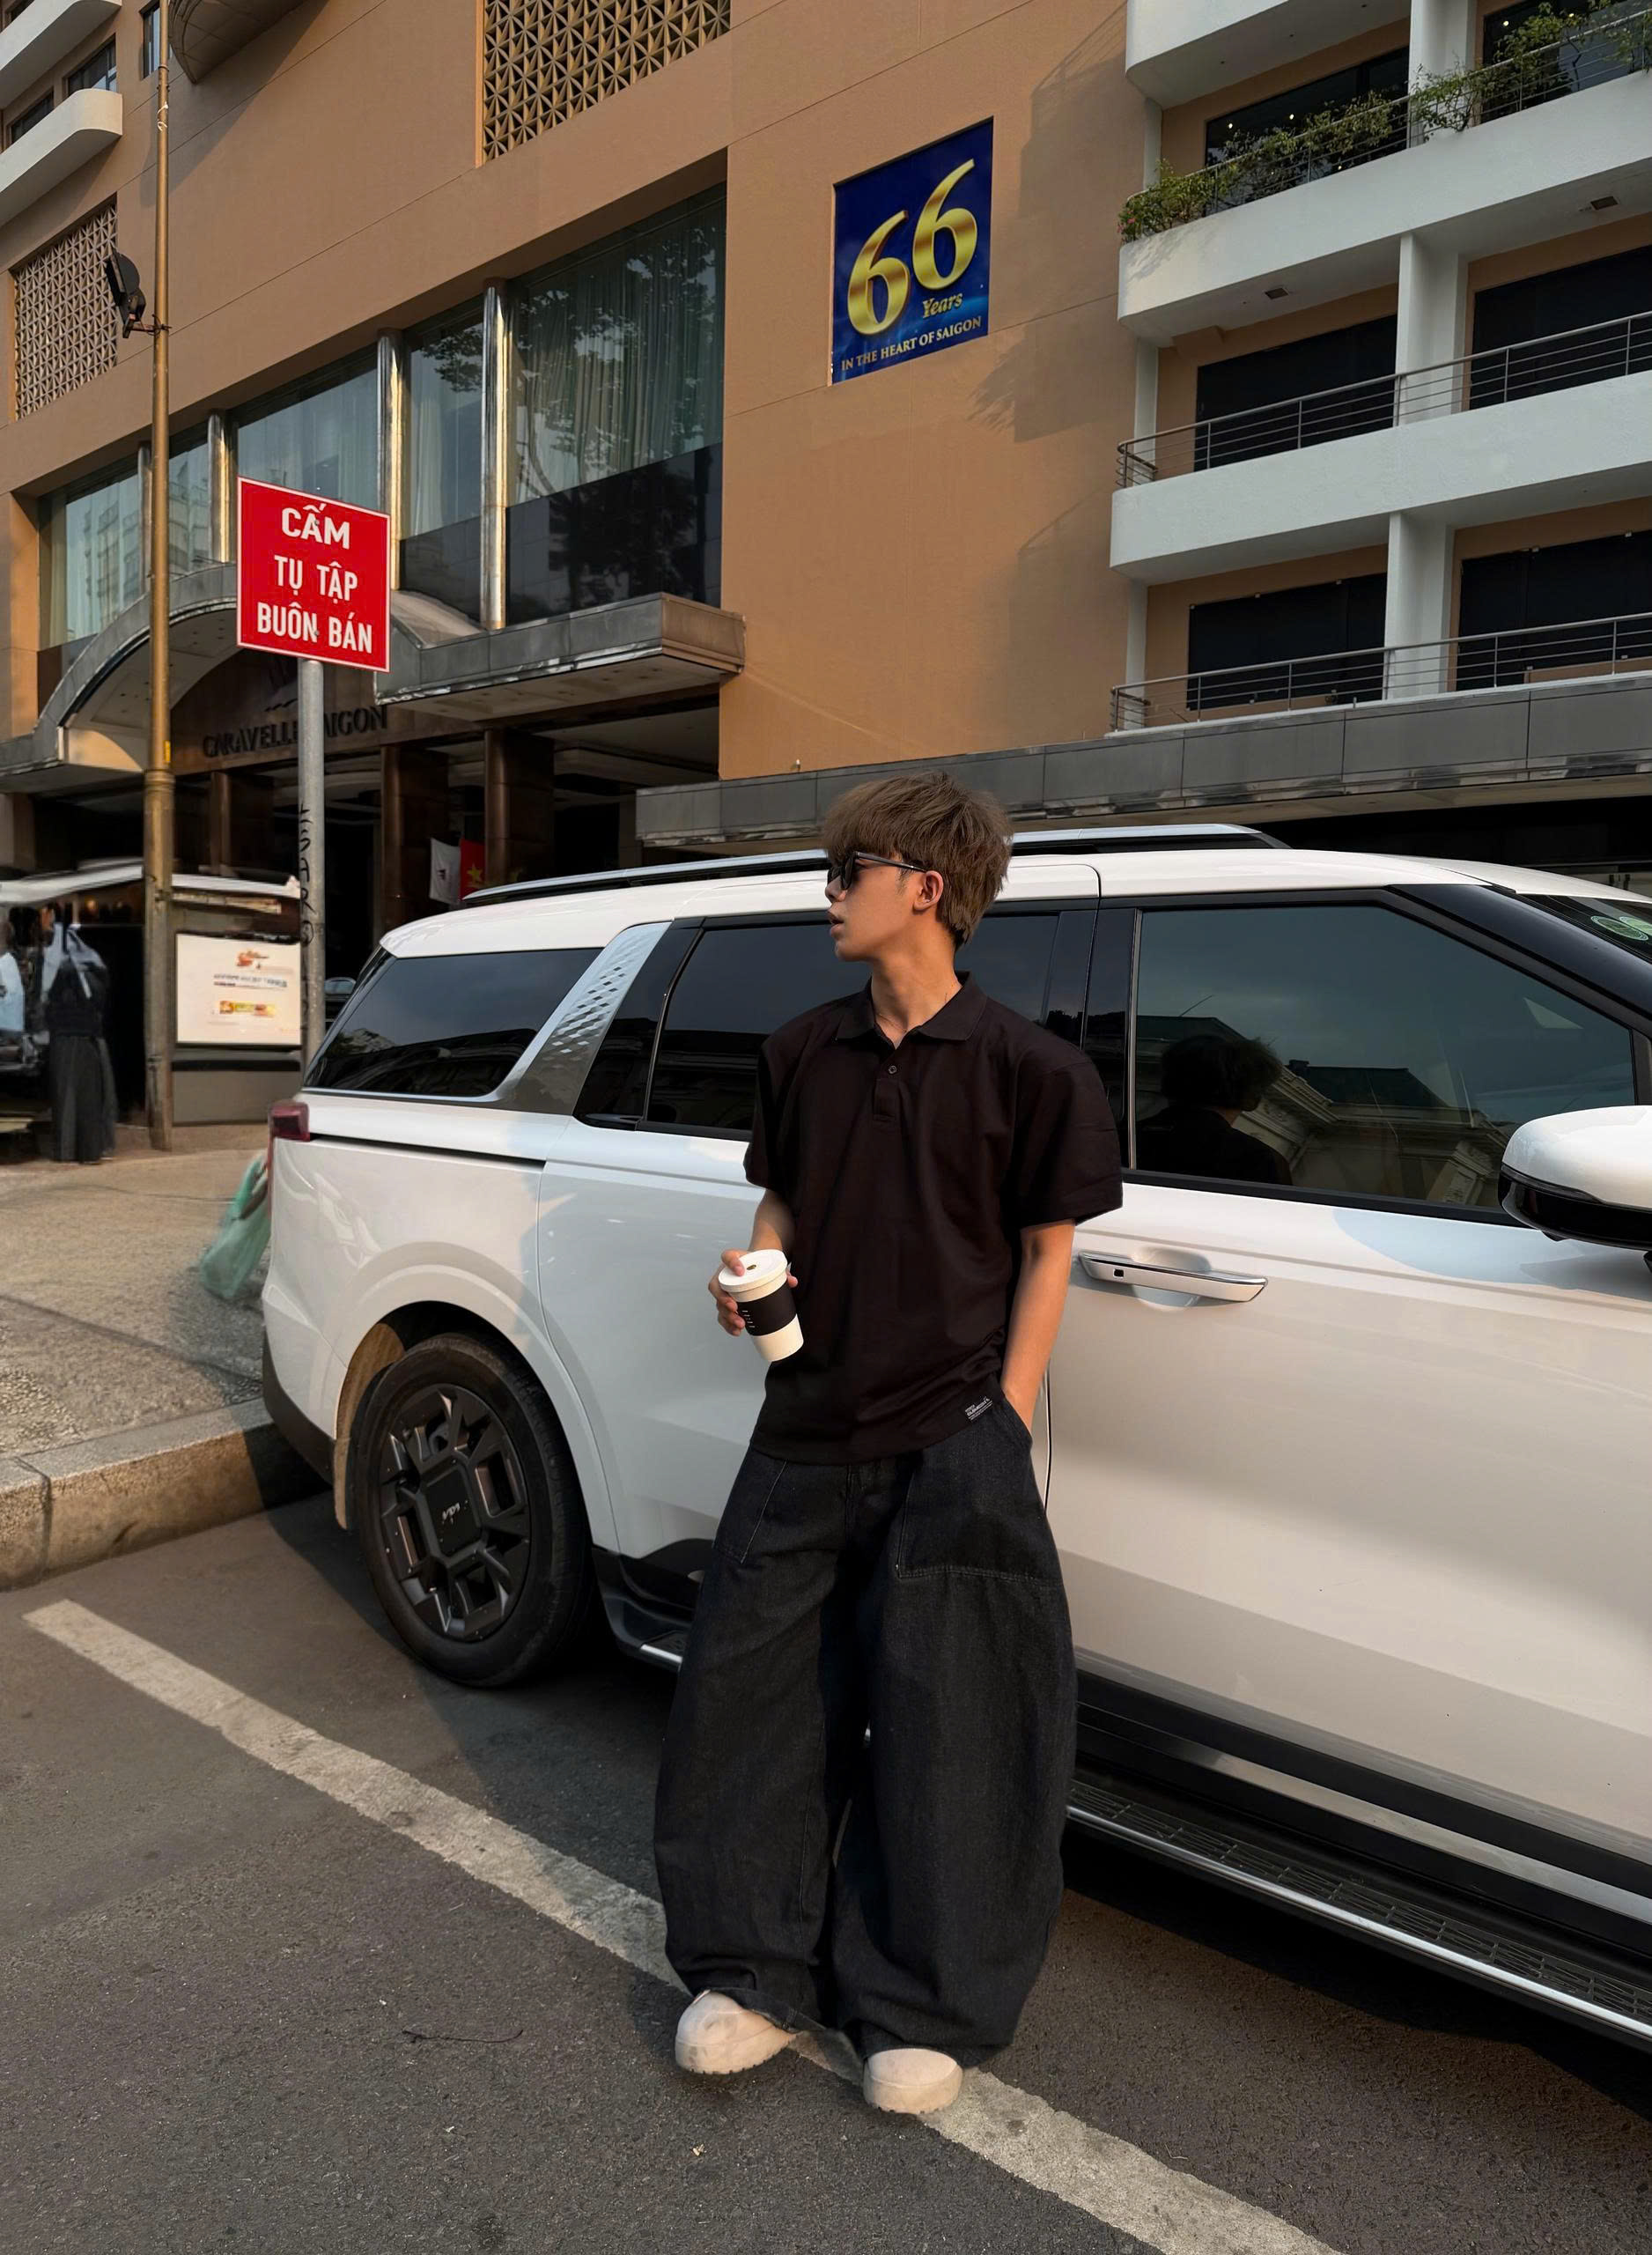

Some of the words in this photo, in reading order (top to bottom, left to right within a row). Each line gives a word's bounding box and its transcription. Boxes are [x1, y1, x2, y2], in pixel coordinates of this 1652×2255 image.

[847, 159, 977, 336] 66
[922, 292, 963, 319] Years
[841, 358, 853, 371] IN
[856, 351, 877, 366] THE
[881, 337, 918, 359] HEART
[918, 331, 934, 346] OF
[936, 316, 982, 341] SAIGON
[282, 503, 350, 550] CẤM
[274, 554, 303, 596] TỤ
[316, 561, 358, 604] TẬP
[257, 602, 318, 643] BUÔN
[328, 612, 372, 654] BÁN
[324, 705, 388, 738] IGON
